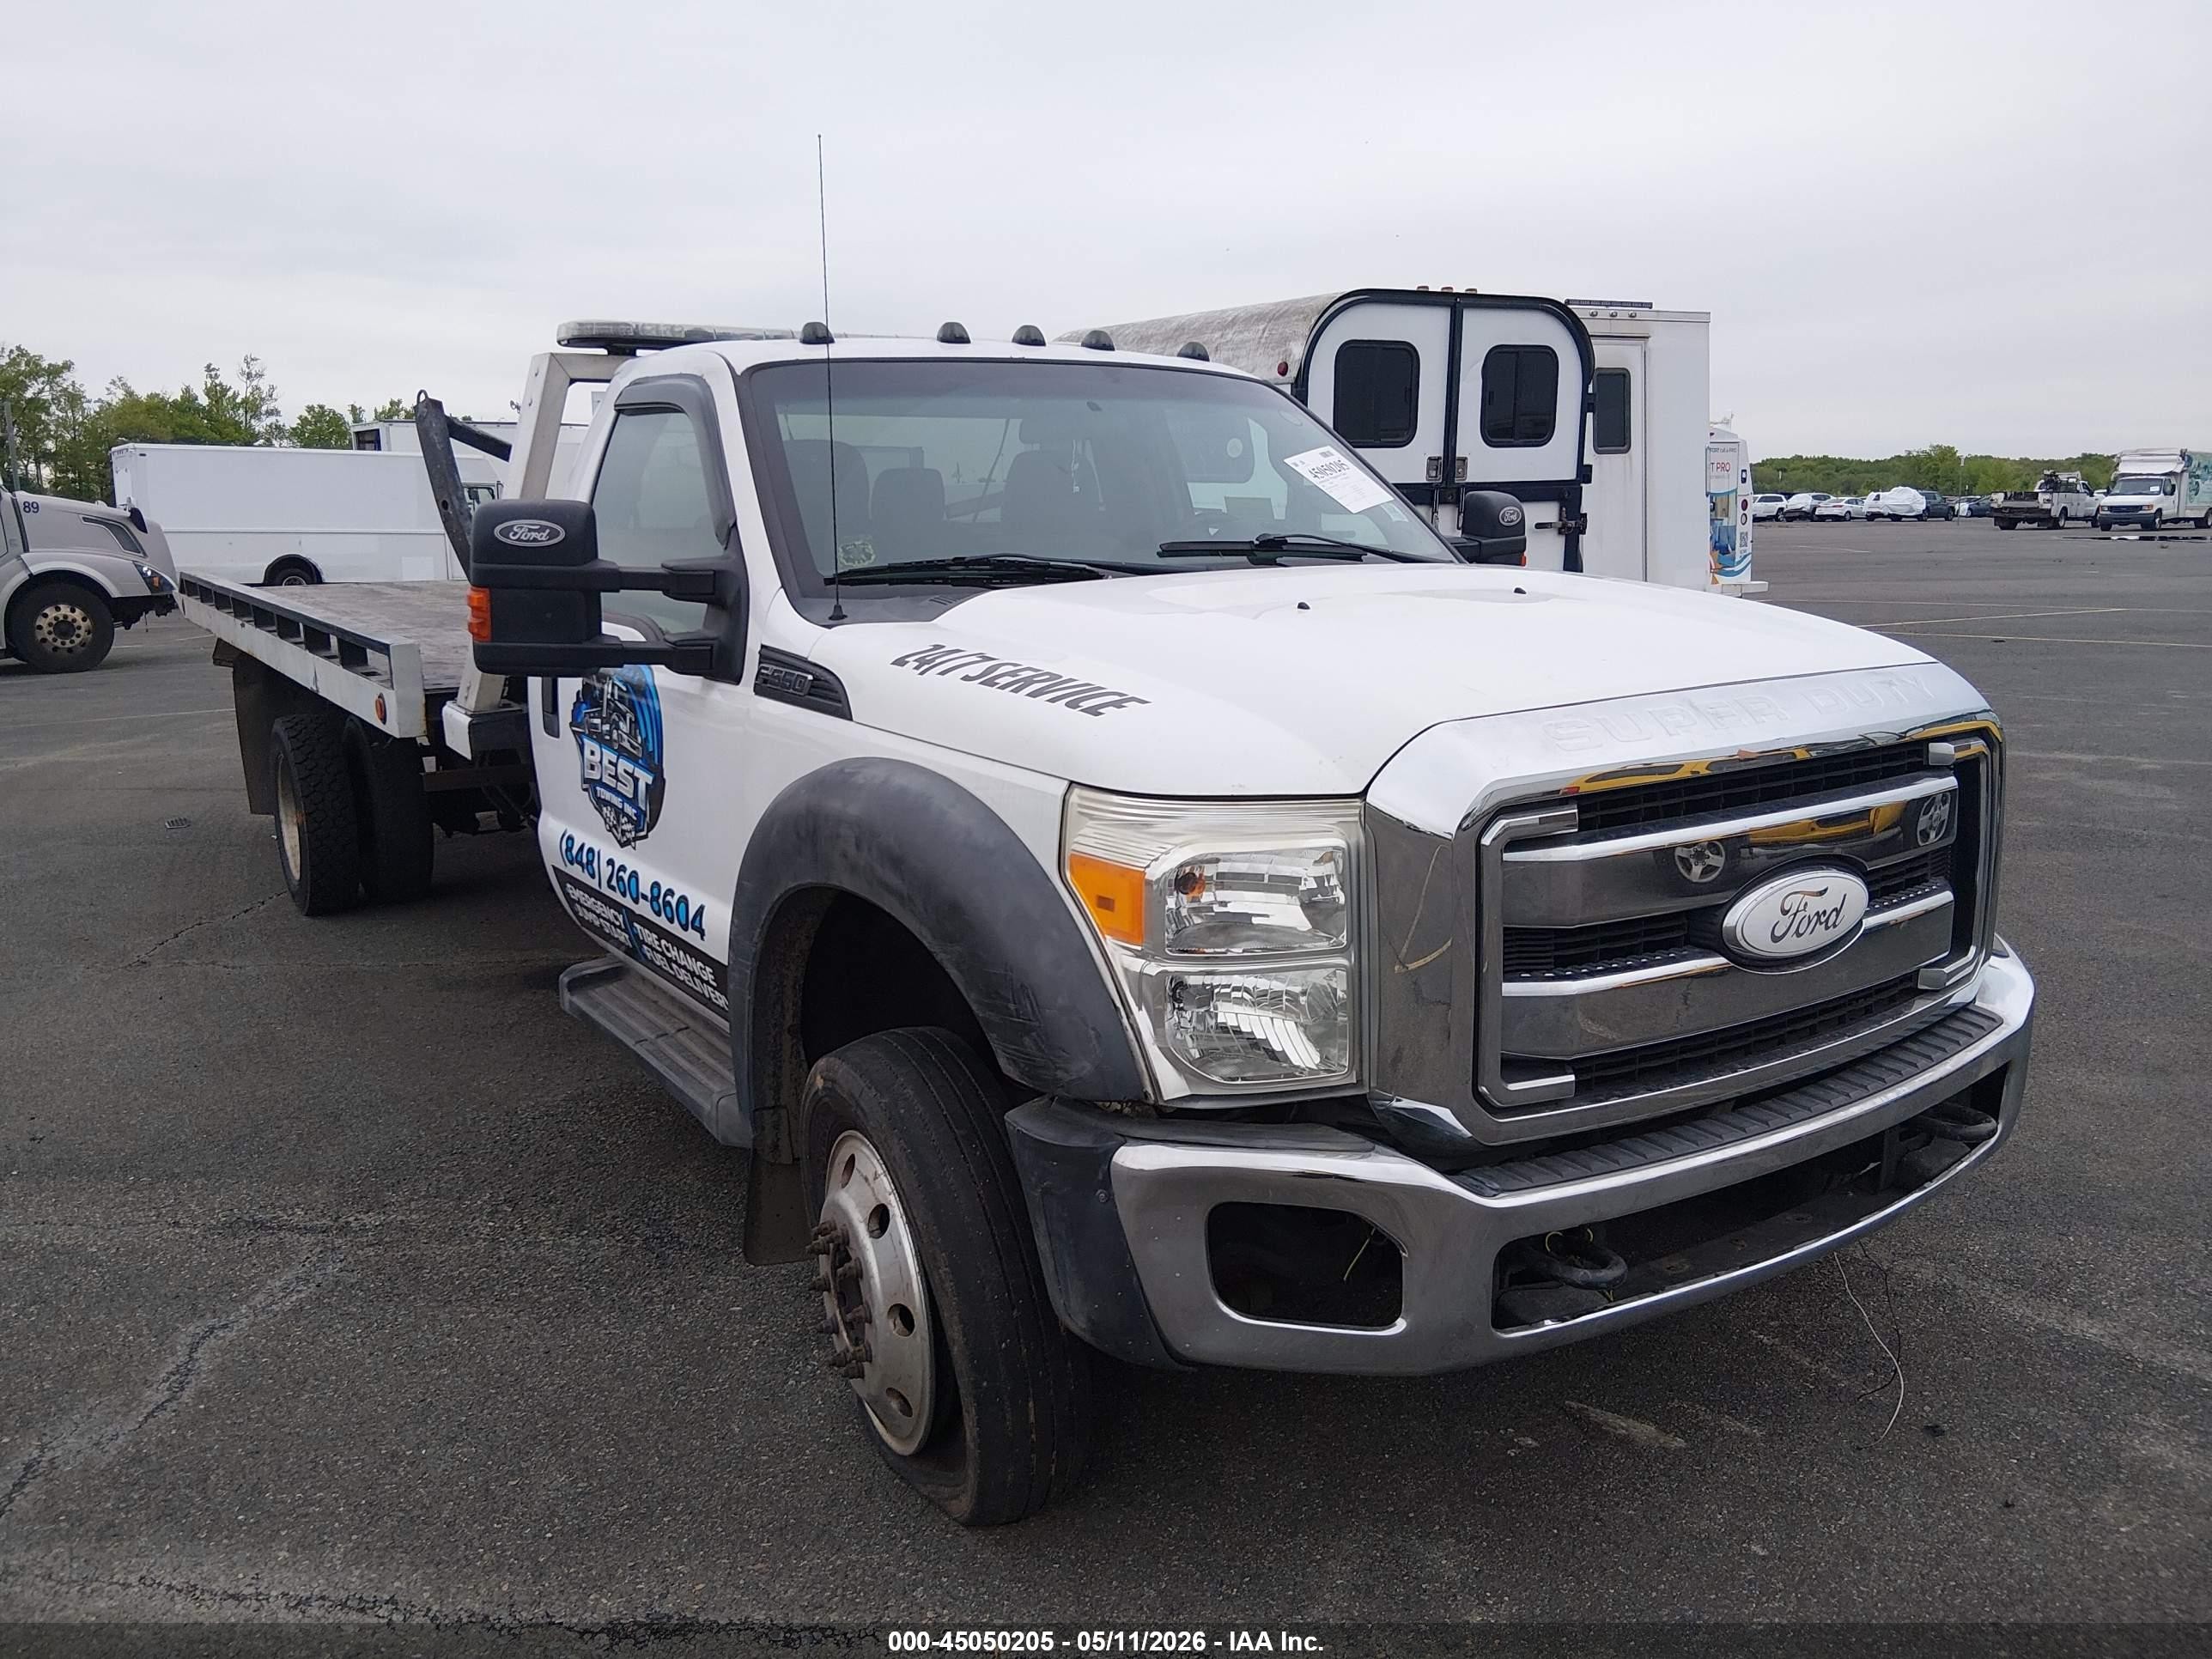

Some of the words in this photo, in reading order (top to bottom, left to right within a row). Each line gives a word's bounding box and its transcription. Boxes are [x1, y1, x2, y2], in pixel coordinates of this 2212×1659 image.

[1716, 461, 1731, 472] PRO
[22, 501, 40, 514] 89
[508, 524, 550, 541] Ford
[890, 643, 1000, 677] 24/7
[959, 661, 1152, 718] SERVICE
[1543, 694, 1791, 752] SUPER
[1803, 673, 1937, 715] DUTY
[583, 741, 653, 811] BEST
[595, 786, 623, 810] TOWING
[605, 858, 707, 941] 260-8604
[1770, 885, 1847, 944] Ford
[634, 921, 662, 951] TIRE
[660, 939, 718, 987] CHANGE
[643, 945, 675, 975] FUEL
